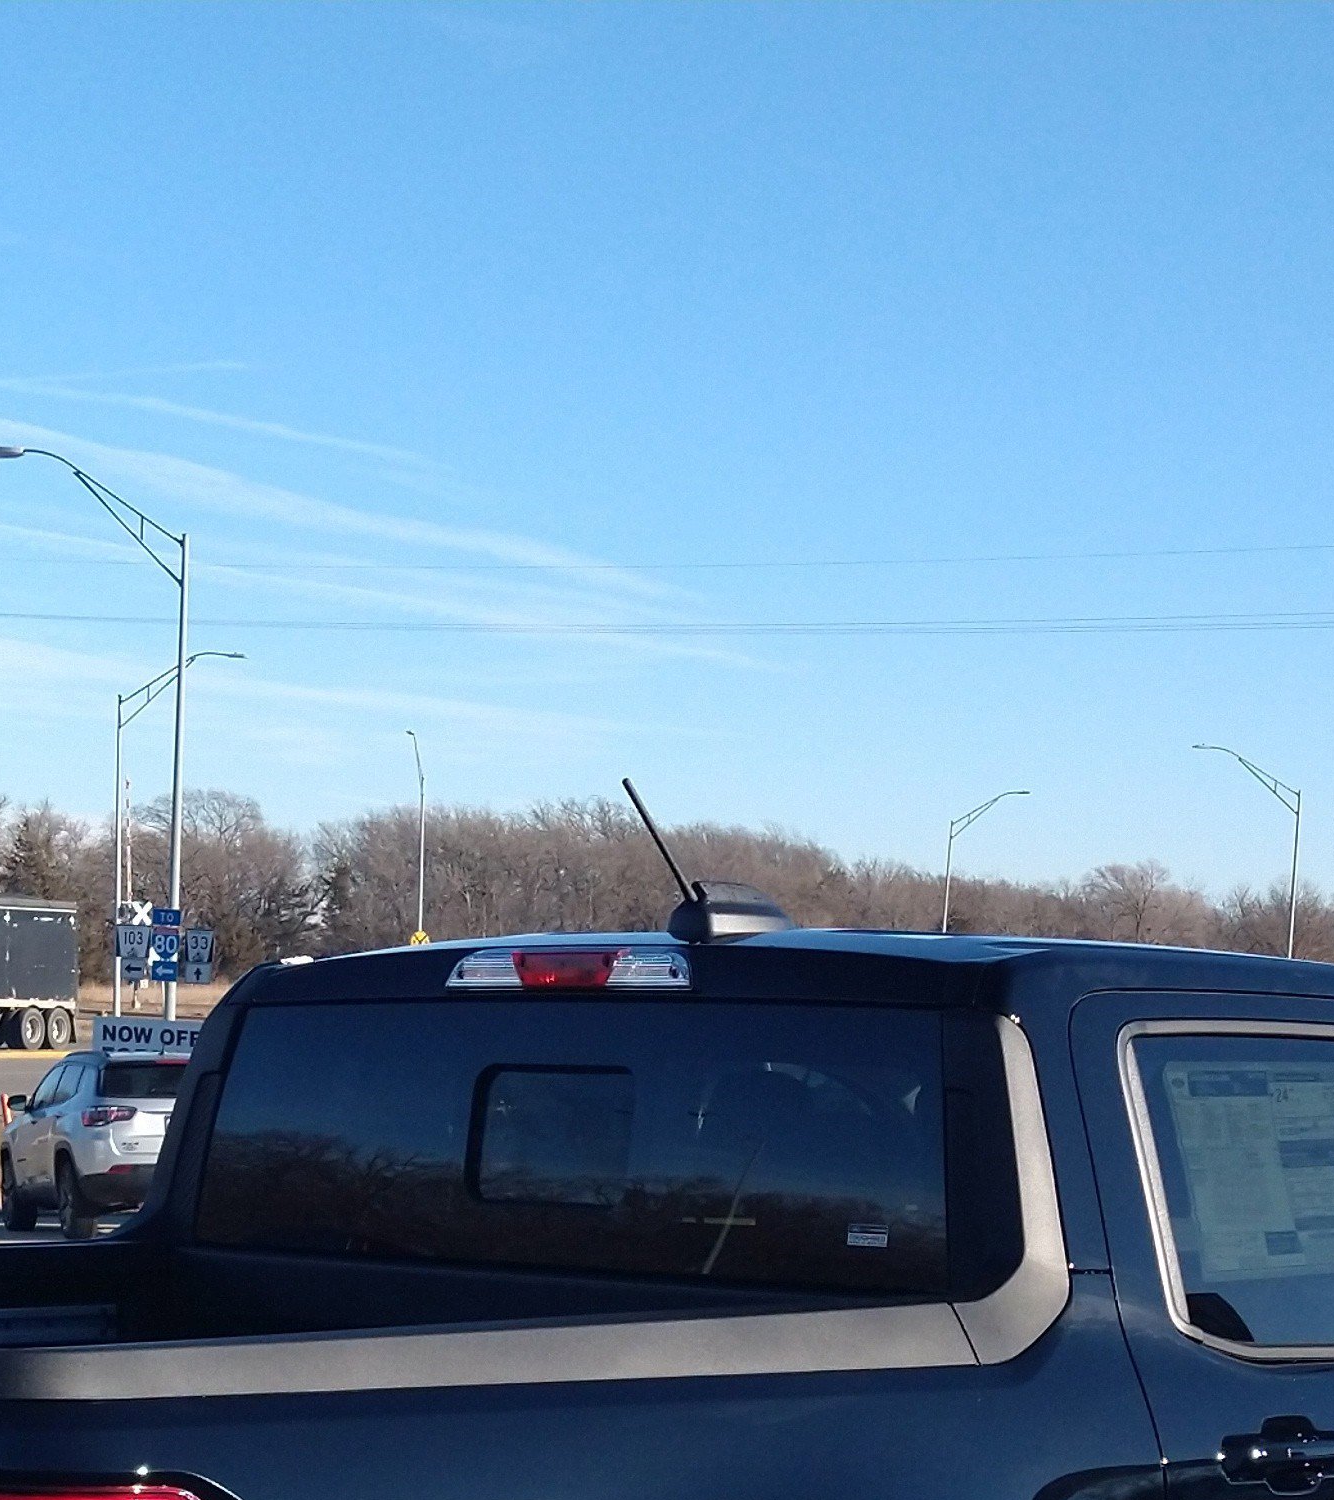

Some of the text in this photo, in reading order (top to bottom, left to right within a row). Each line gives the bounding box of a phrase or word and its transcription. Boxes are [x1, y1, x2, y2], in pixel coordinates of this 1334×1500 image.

[160, 912, 174, 922] TO
[124, 930, 143, 945] 103
[154, 935, 177, 953] 80
[191, 936, 208, 949] 33
[102, 1025, 153, 1043] NOW
